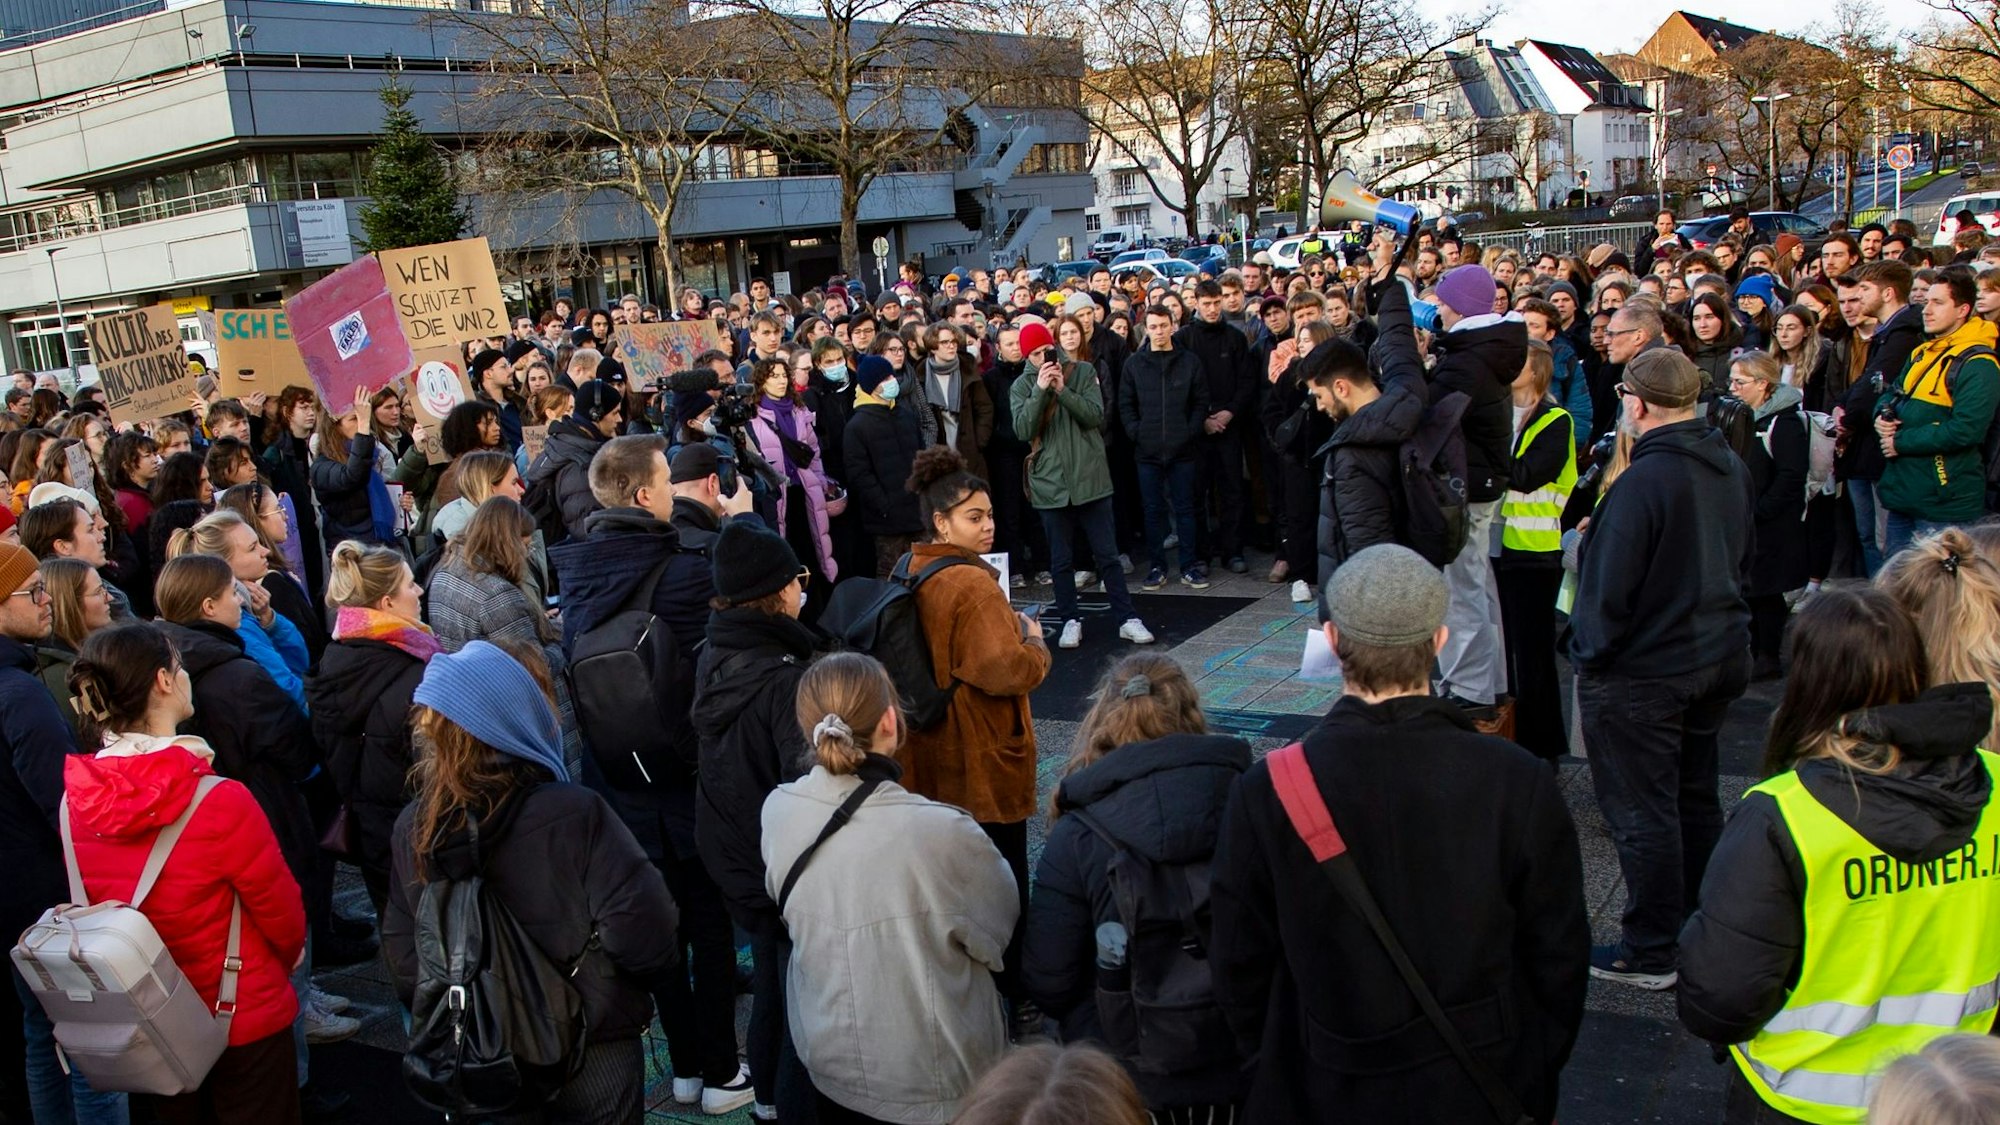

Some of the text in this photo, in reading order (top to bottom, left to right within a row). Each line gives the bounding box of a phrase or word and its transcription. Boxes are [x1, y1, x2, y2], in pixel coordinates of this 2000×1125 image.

[286, 204, 316, 213] Universität
[395, 254, 450, 285] WEN
[398, 286, 476, 318] SCHÜTZT
[86, 310, 174, 364] KULTUR DES
[221, 311, 294, 341] SCHE
[340, 320, 359, 350] FAILED
[410, 317, 446, 340] DIE
[99, 343, 190, 403] HINSCHAUENS?
[1843, 834, 2000, 900] ORDNER.I
